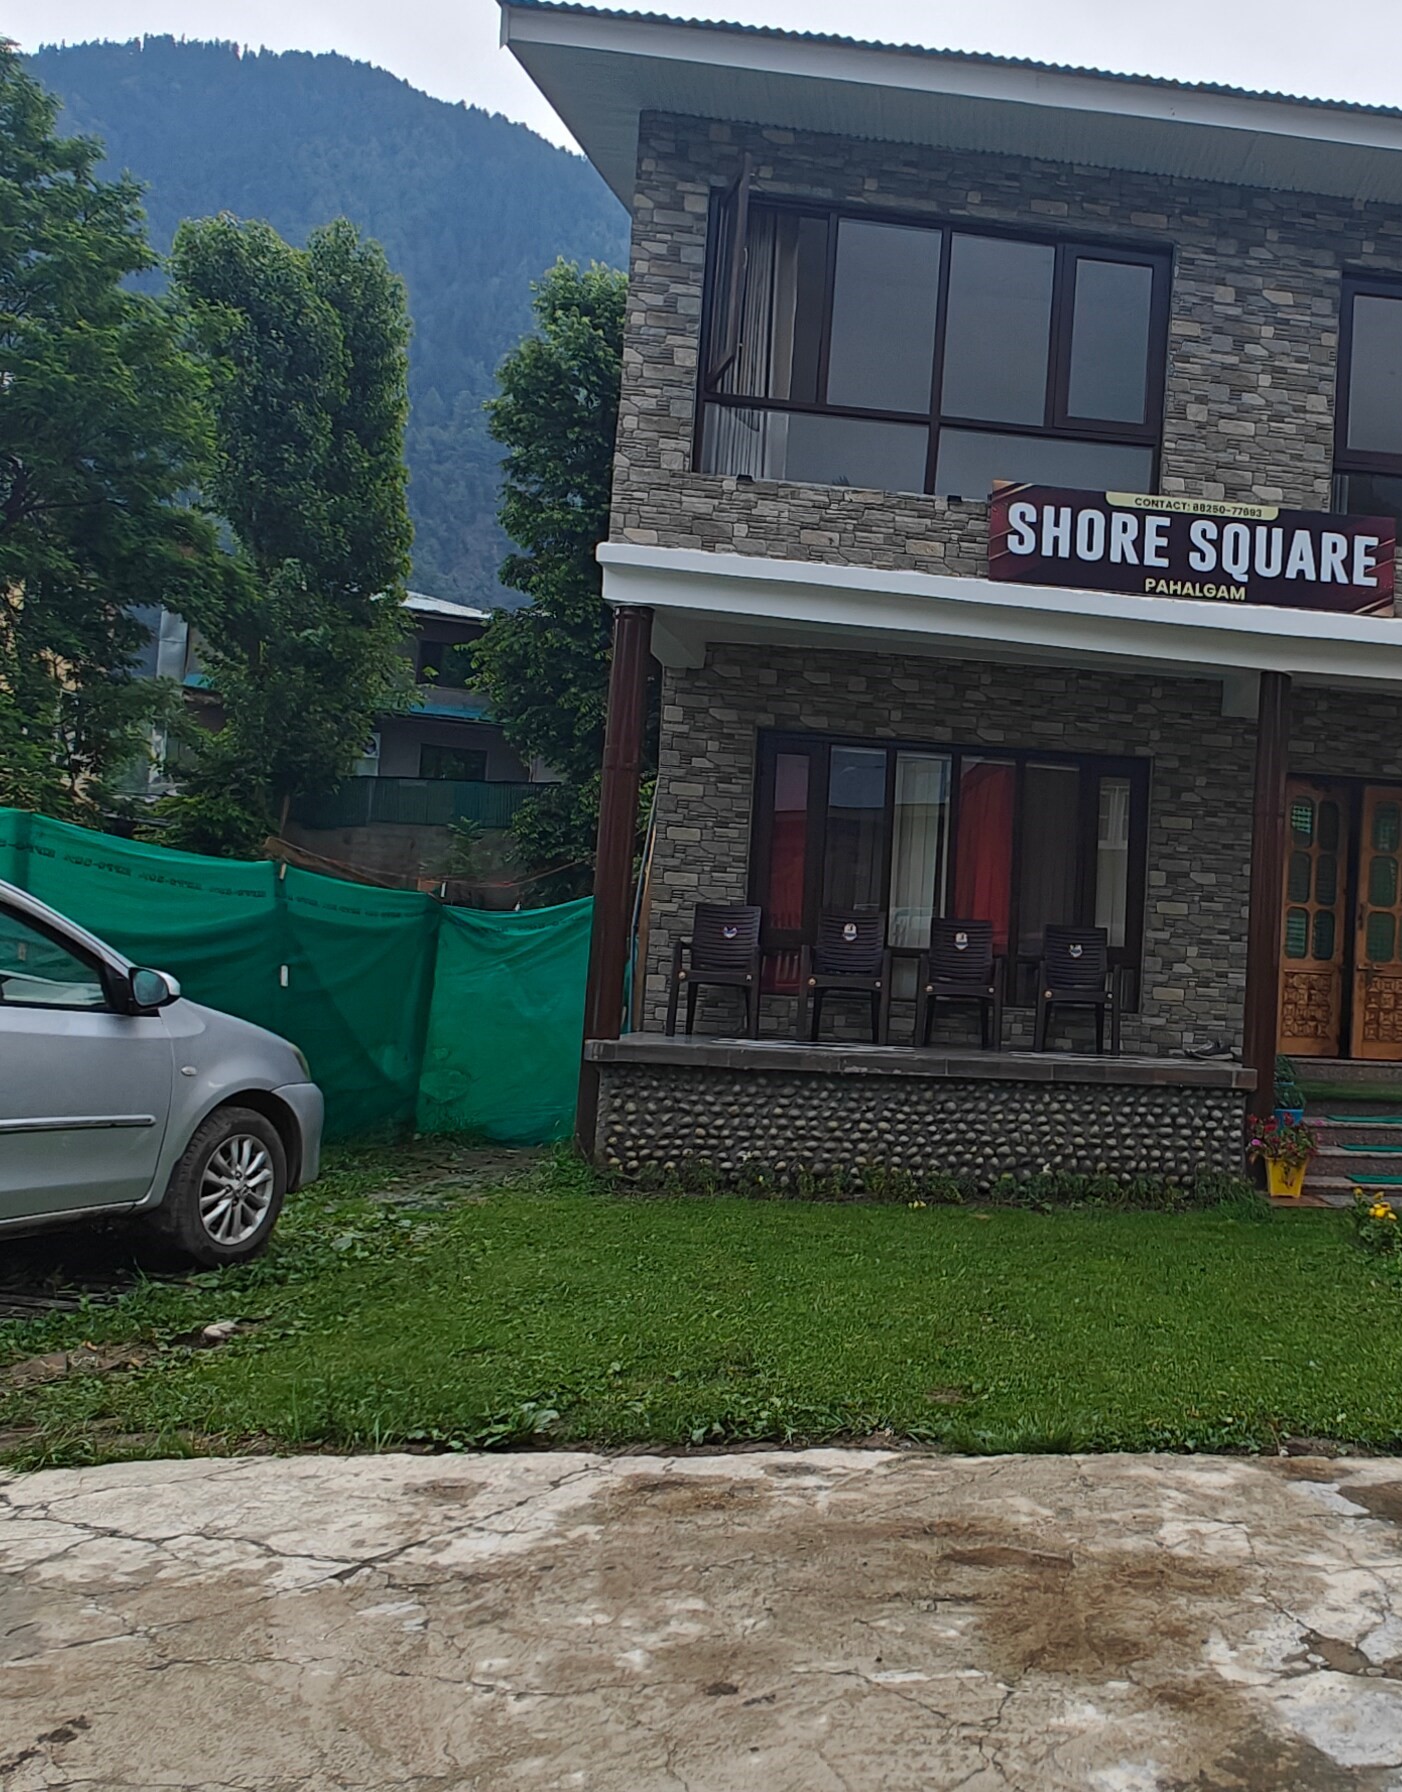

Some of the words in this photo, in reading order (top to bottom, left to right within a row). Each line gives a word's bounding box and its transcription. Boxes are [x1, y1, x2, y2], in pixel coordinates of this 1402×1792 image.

[1134, 497, 1190, 511] CONTACT:
[1007, 501, 1171, 568] SHORE
[1188, 518, 1380, 588] SQUARE
[1145, 577, 1246, 601] PAHALGAM
